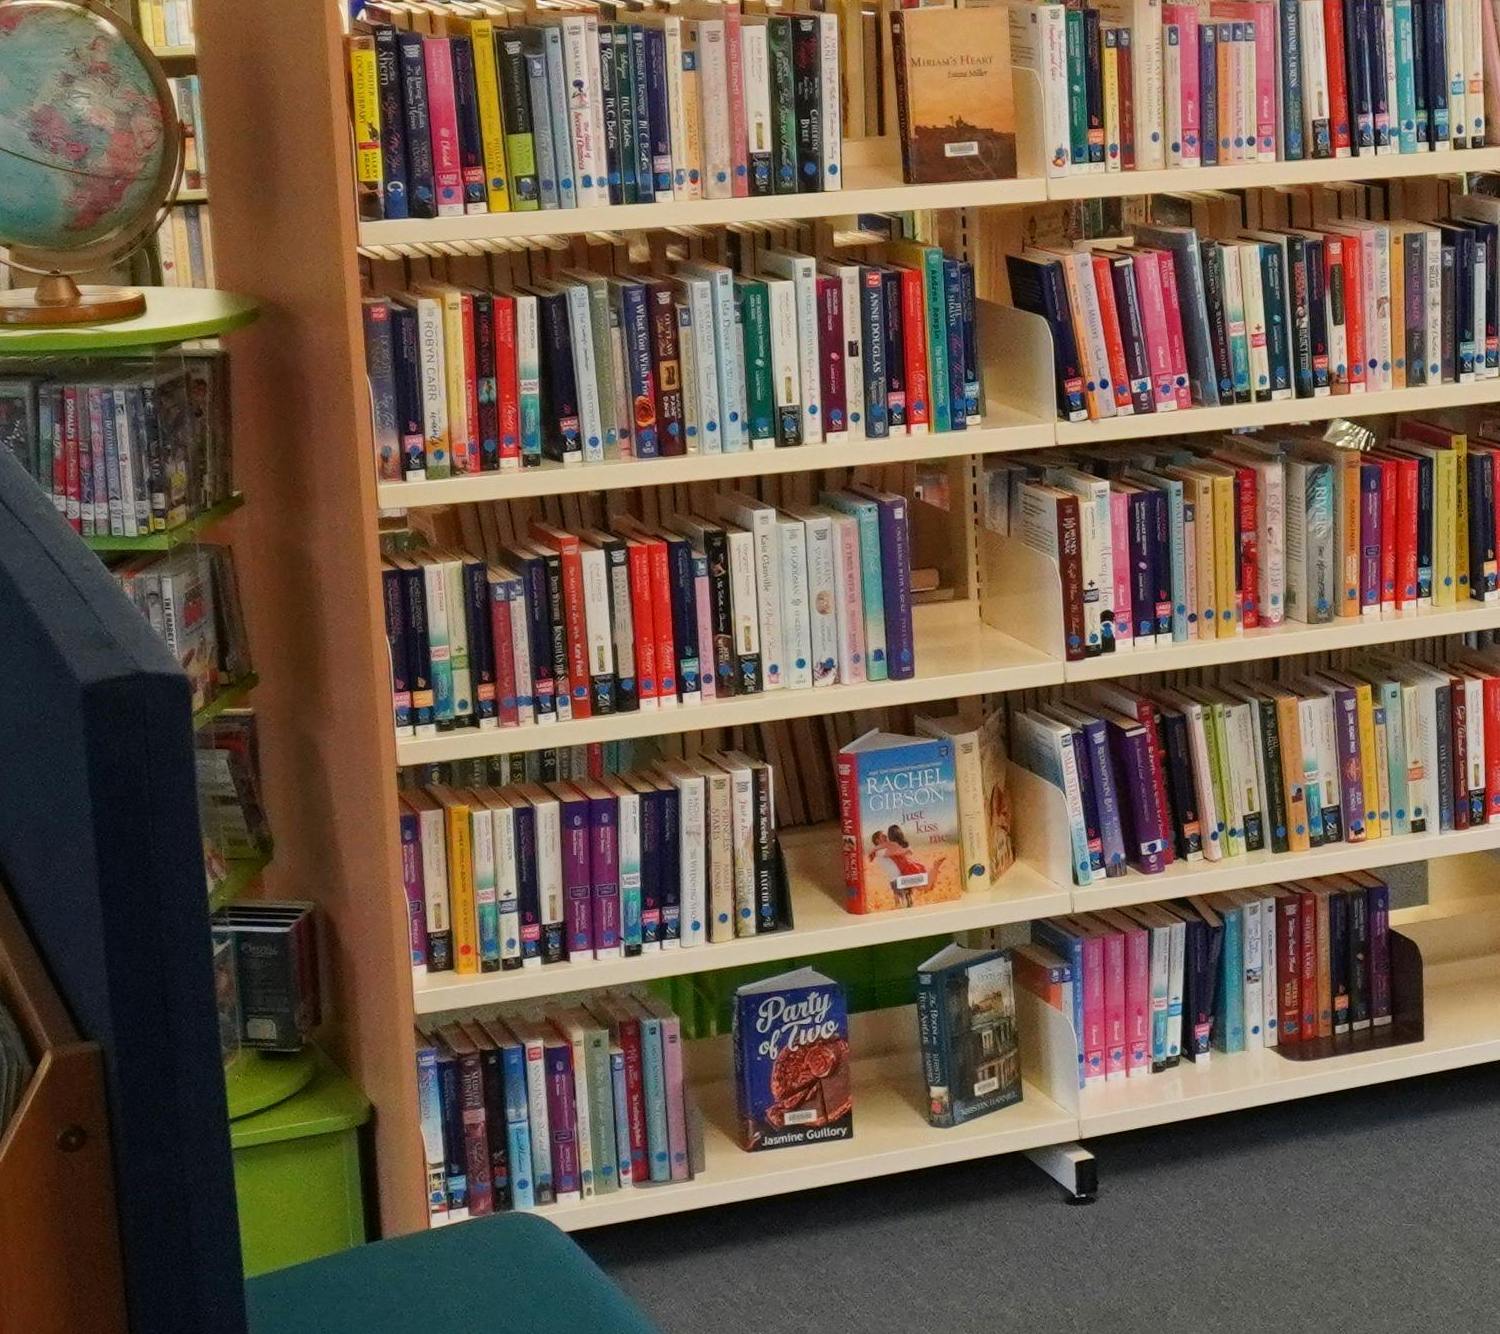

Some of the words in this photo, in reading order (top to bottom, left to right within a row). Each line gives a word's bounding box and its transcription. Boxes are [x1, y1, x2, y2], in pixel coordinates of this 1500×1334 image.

[958, 53, 994, 66] HEART
[866, 767, 946, 795] RACHEL
[868, 786, 946, 812] GIBSON
[901, 809, 925, 826] just
[915, 818, 939, 834] kiss
[756, 993, 832, 1033] Party
[758, 1036, 780, 1060] of
[782, 1018, 839, 1052] Two
[762, 1131, 805, 1146] Jasmine
[806, 1124, 848, 1141] Guillory
